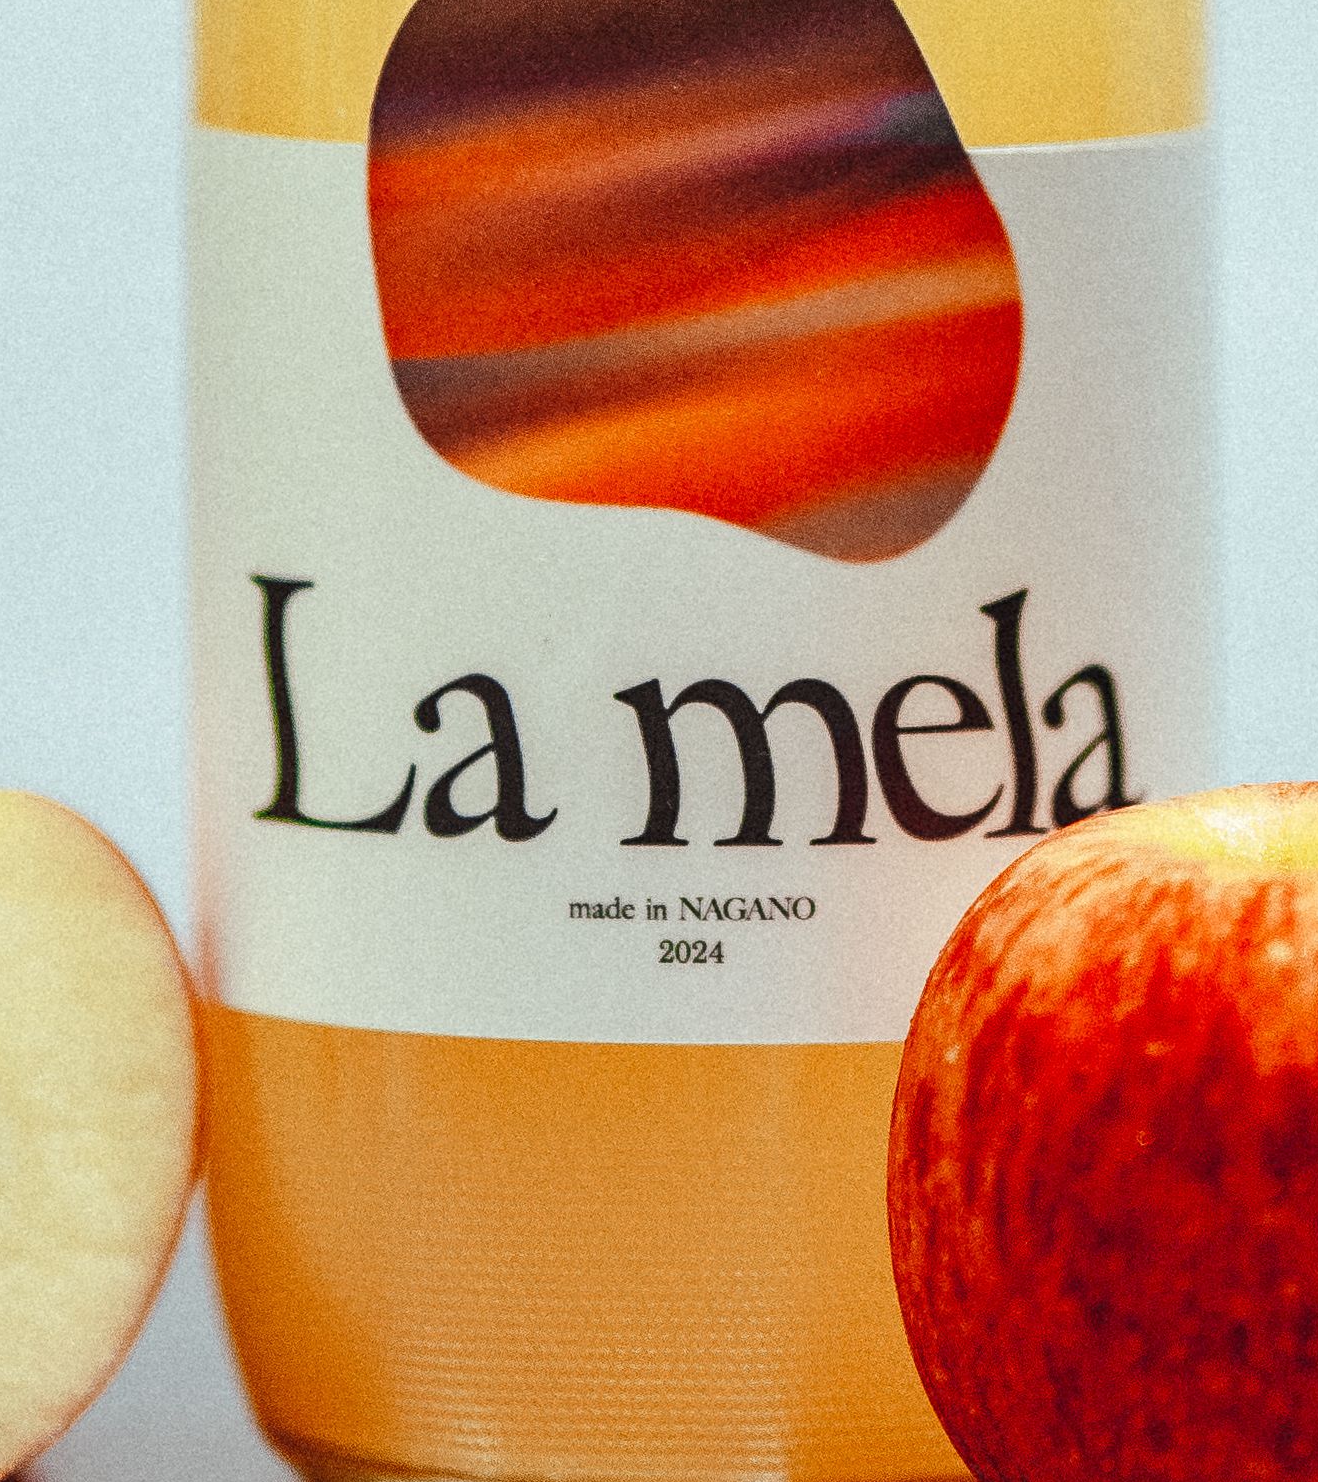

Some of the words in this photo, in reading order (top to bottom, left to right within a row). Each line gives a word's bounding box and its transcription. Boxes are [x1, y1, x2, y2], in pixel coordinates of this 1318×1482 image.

[250, 573, 559, 842] La
[613, 587, 1146, 847] mela
[568, 897, 635, 920] made
[646, 898, 668, 921] in
[679, 896, 816, 921] NAGANO
[659, 939, 725, 964] 2024
